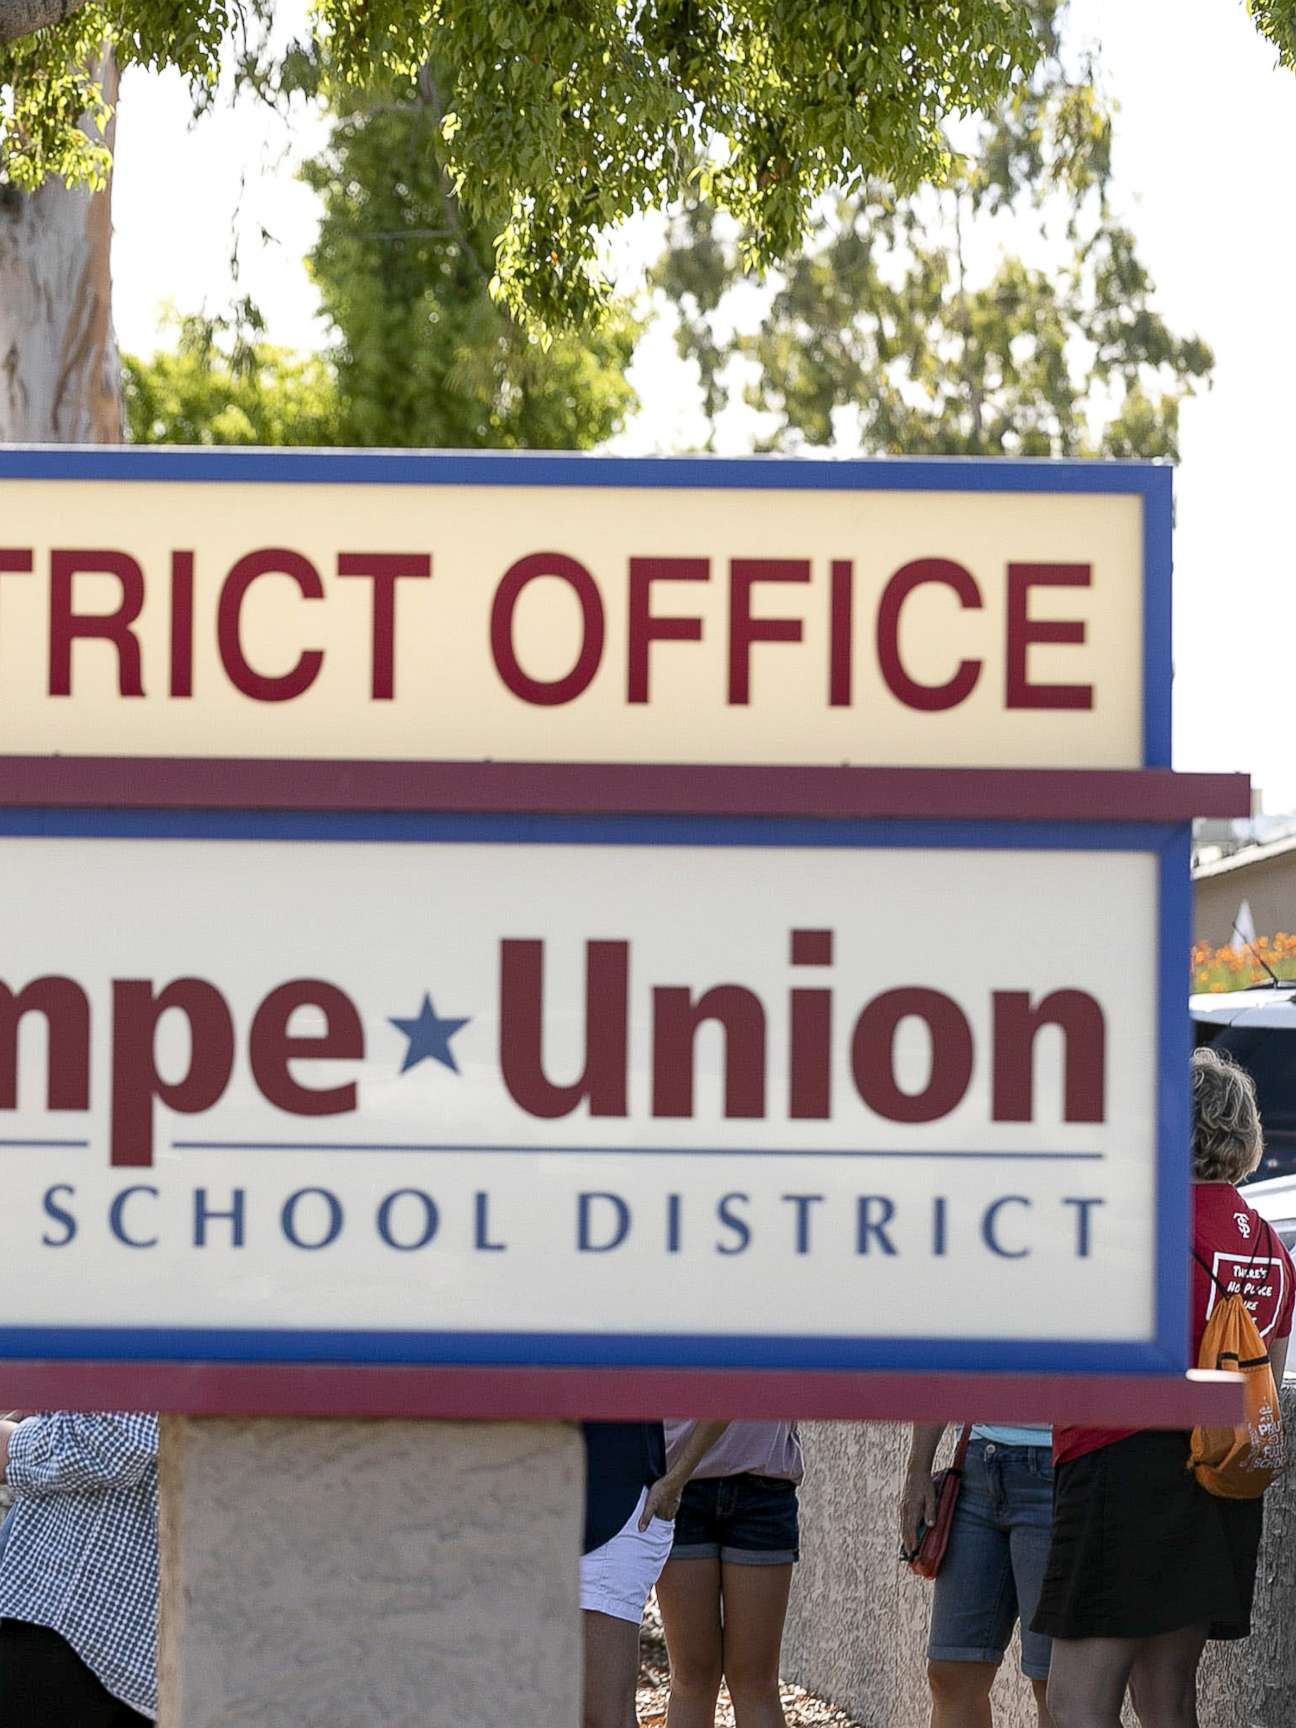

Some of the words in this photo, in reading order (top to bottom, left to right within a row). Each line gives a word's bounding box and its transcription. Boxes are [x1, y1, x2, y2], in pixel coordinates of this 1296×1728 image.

[490, 552, 1093, 712] OFFICE
[500, 929, 1106, 1124] Union
[42, 1185, 506, 1251] SCHOOL
[578, 1193, 1103, 1258] DISTRICT
